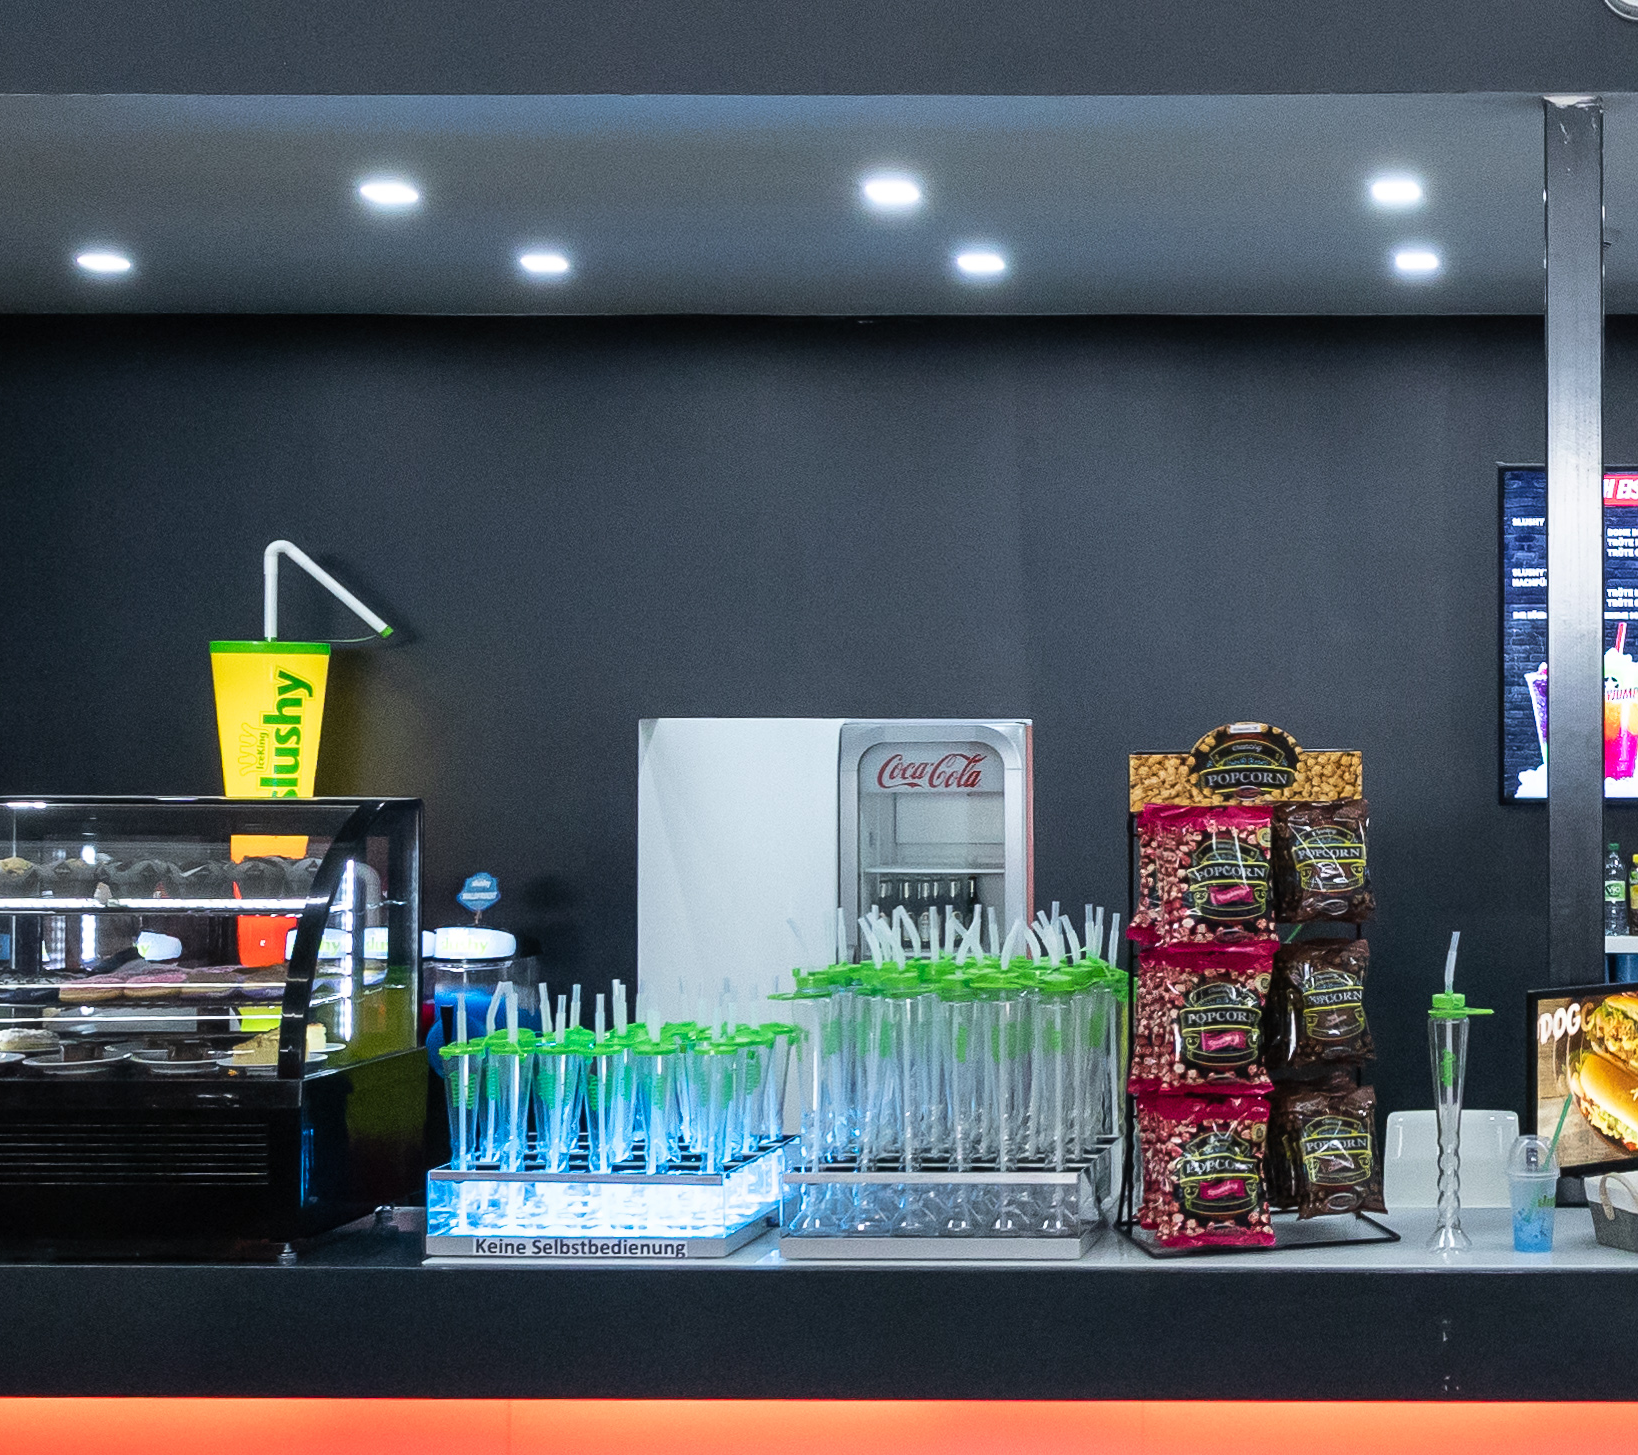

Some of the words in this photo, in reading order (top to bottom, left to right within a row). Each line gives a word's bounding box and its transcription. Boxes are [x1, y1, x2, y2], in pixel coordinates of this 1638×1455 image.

[256, 732, 268, 769] IceKing
[877, 752, 987, 788] Coca-Cola
[1208, 771, 1288, 786] POPCORN
[1298, 846, 1360, 859] POPCORN
[475, 1239, 526, 1254] Keine
[532, 1239, 686, 1257] Selbstbedienung
